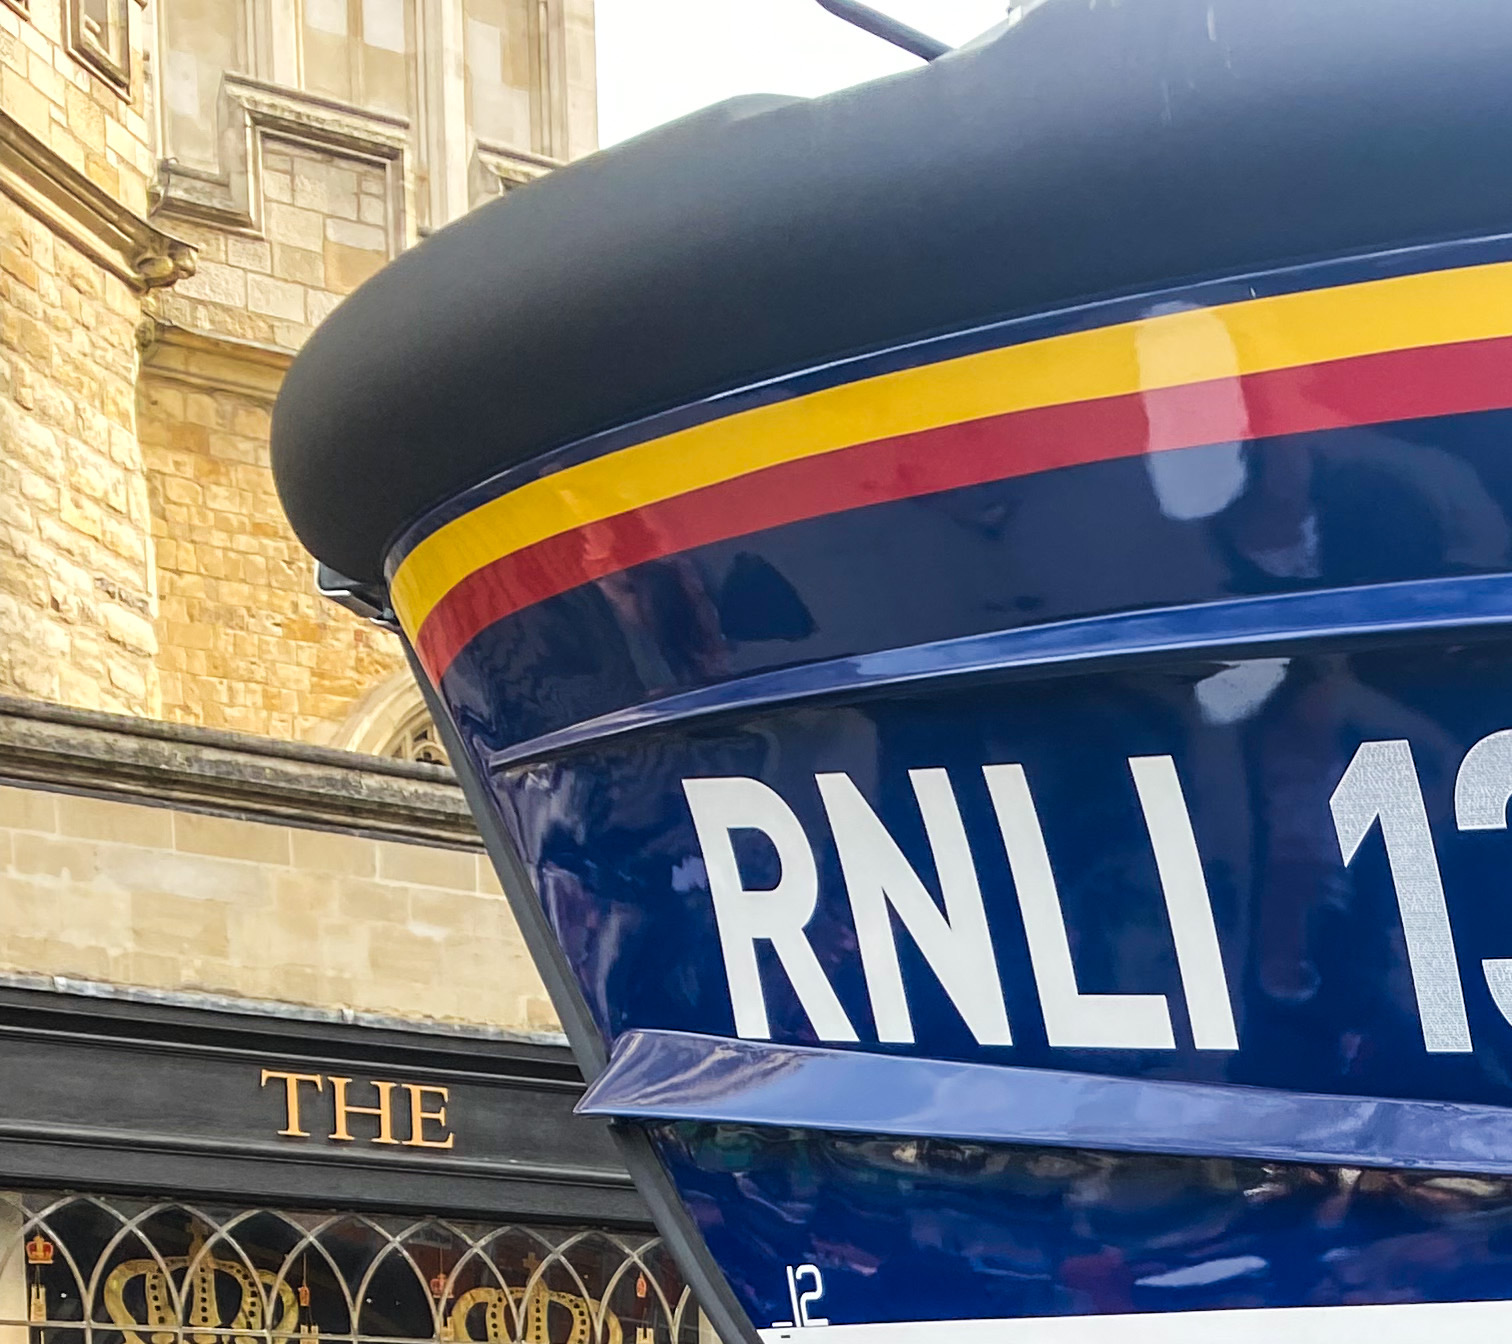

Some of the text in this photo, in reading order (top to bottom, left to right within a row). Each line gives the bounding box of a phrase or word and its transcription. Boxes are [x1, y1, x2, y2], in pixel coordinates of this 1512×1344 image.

[682, 754, 1239, 1051] RNLI
[260, 1068, 455, 1149] THE
[786, 1264, 829, 1327] 12
